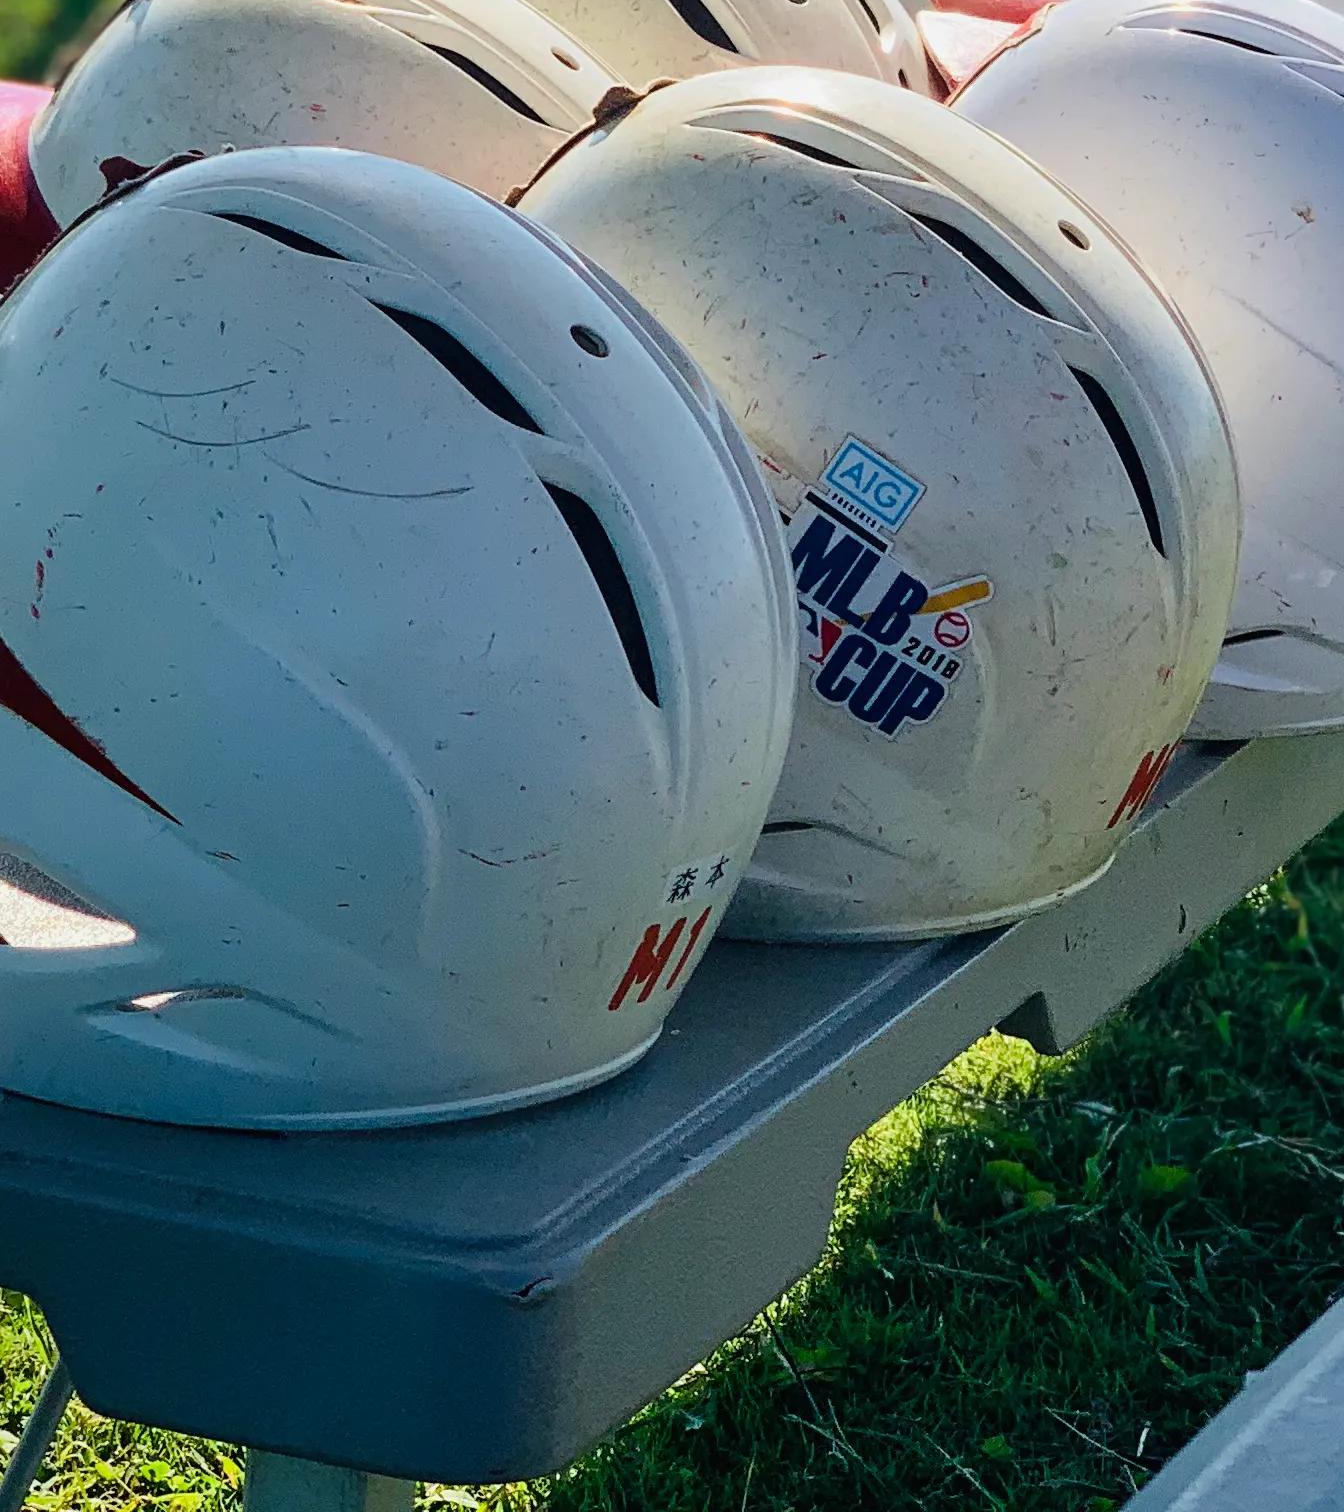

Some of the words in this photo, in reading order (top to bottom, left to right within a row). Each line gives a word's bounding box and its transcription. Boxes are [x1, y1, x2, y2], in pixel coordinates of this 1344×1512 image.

[839, 462, 903, 510] AIG
[792, 514, 928, 646] MLB
[902, 637, 961, 679] 2018
[815, 634, 945, 736] CUP
[666, 855, 730, 904] 森本
